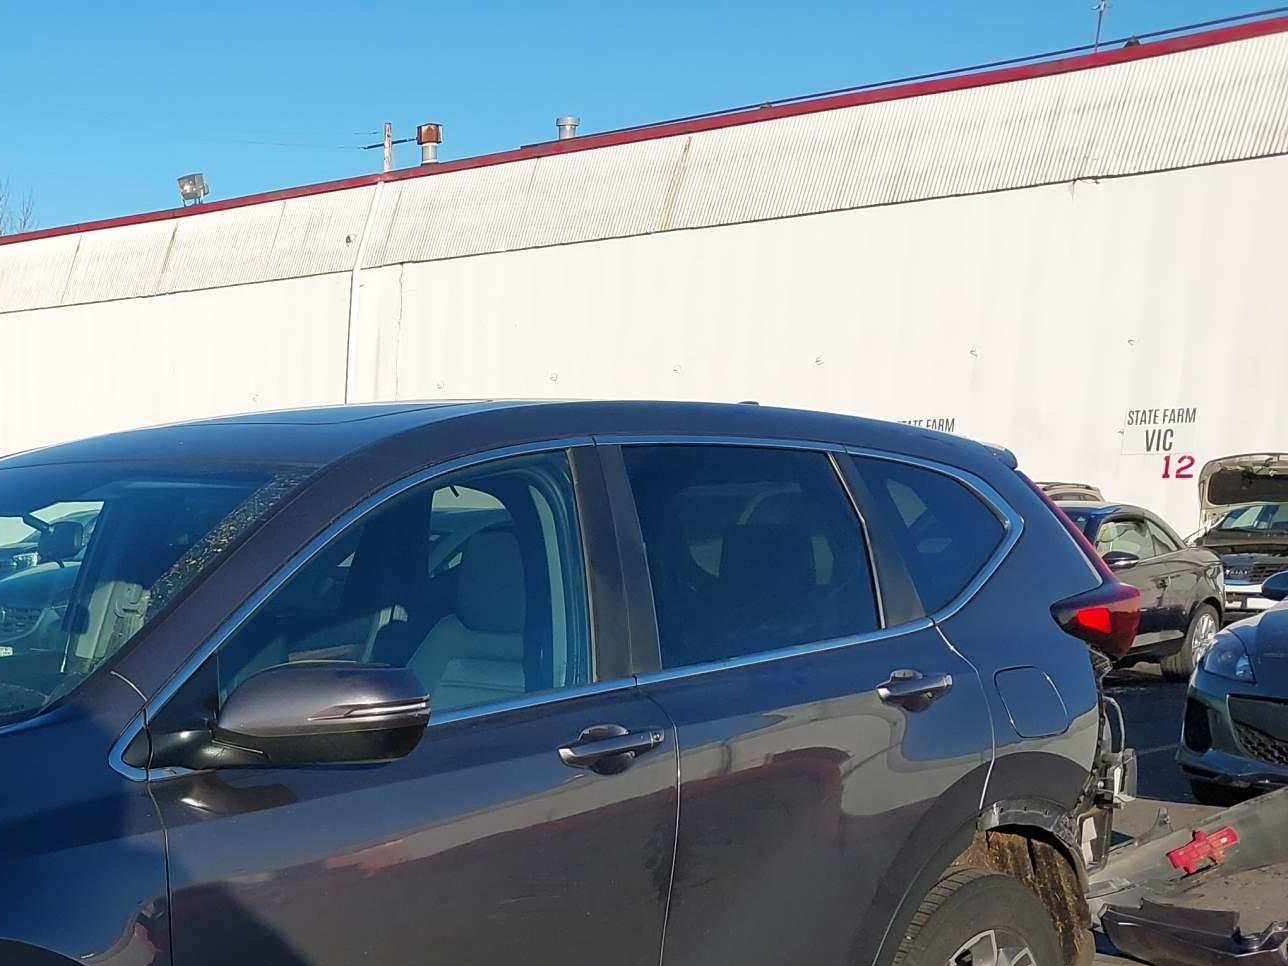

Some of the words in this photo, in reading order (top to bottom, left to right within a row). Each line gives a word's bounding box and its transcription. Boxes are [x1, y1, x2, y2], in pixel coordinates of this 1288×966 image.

[1127, 408, 1160, 426] STATE
[1162, 407, 1197, 425] FARM
[1145, 428, 1174, 452] VIC
[1162, 455, 1195, 479] 12
